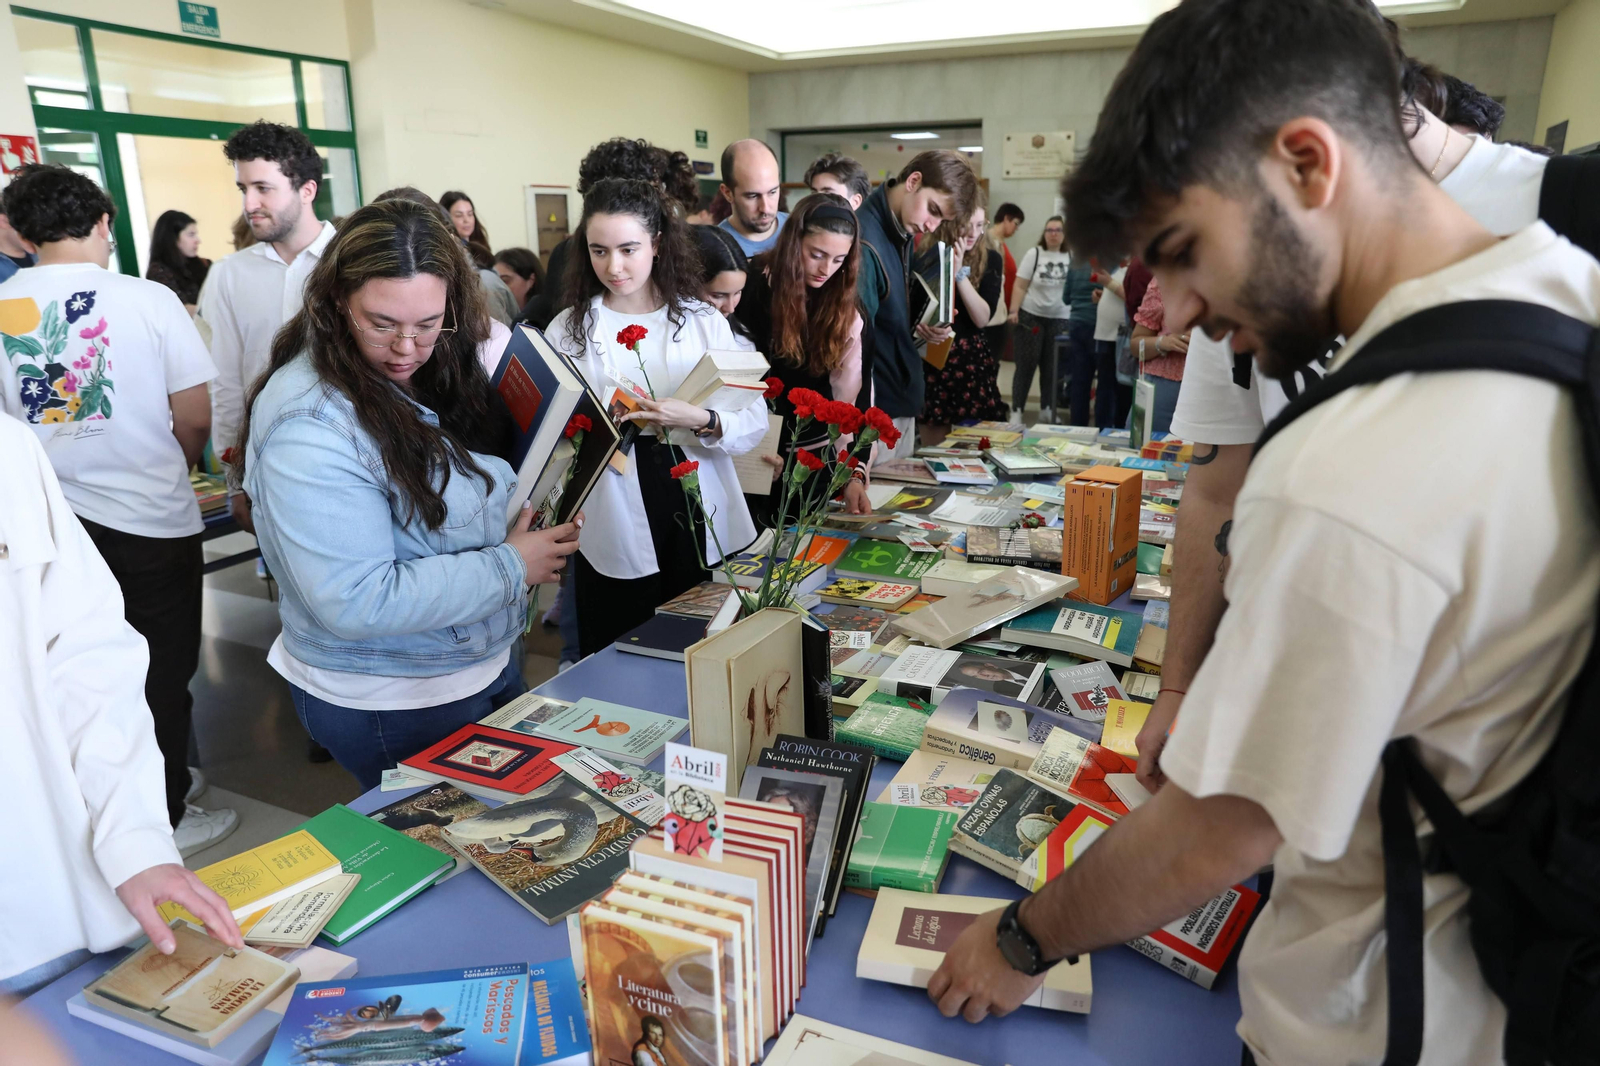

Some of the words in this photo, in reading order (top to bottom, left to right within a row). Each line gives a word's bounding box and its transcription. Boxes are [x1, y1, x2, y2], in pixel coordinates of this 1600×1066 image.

[898, 652, 920, 673] MIGUEL
[906, 650, 936, 679] CASTILLEJO
[1058, 664, 1105, 679] WOOLRICH
[780, 741, 819, 756] ROBIN
[821, 748, 863, 762] COOK
[927, 734, 953, 746] Perspectivas
[927, 742, 955, 754] Fundamentos
[671, 755, 713, 776] Abril
[766, 752, 805, 765] Nathaniel
[808, 758, 853, 773] Hawthorne
[960, 744, 996, 765] Genética
[1048, 751, 1070, 780] MODERNA
[628, 792, 654, 810] Abril
[898, 788, 910, 804] Abril
[962, 807, 983, 831] RAZAS
[980, 784, 1002, 809] OVINAS
[974, 798, 1008, 837] ESPAÑOLAS
[578, 826, 647, 870] CONDUCTA
[525, 865, 580, 897] ANIMAL
[284, 892, 324, 934] nomenclatura
[1197, 920, 1220, 950] INGENIEROS
[1213, 890, 1237, 923] INDUSTRIALES
[907, 914, 924, 940] Lecturas
[924, 916, 941, 936] Lógica
[210, 978, 255, 1011] CATALANA
[251, 982, 265, 992] LA
[532, 980, 552, 1016] MECÁNICA
[618, 974, 681, 1005] Literatura
[220, 991, 253, 1015] COCINA
[482, 980, 503, 1034] Mariscos
[500, 979, 519, 1033] Pescados
[627, 995, 638, 1007] y
[637, 997, 673, 1018] cine
[537, 1015, 553, 1026] DE
[494, 1036, 508, 1044] y
[539, 1026, 558, 1058] FLUIDOS
